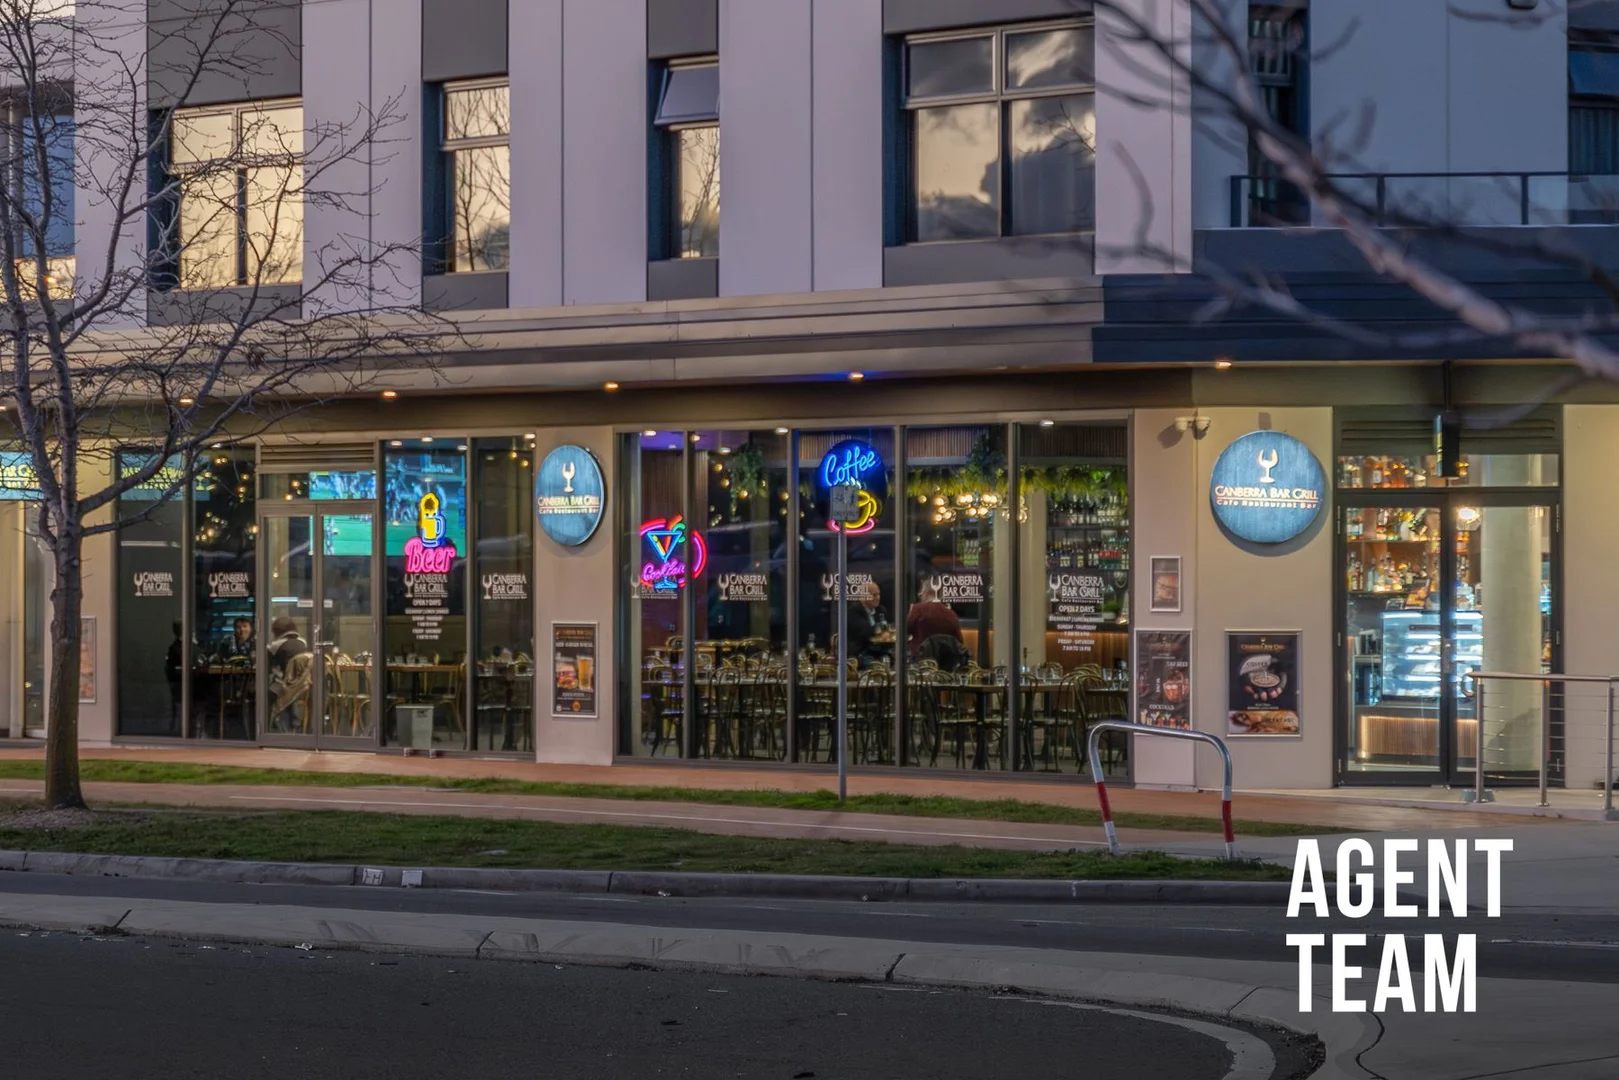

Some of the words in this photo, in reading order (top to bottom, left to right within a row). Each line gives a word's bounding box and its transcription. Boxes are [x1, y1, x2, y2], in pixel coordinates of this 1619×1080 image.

[825, 446, 876, 487] Coffee
[1215, 485, 1268, 498] CANBERRA
[1270, 487, 1290, 499] BAR
[1292, 488, 1319, 500] GRILL
[538, 495, 570, 506] CANBERRA
[570, 495, 583, 506] BAR
[584, 495, 600, 506] GRILL
[1242, 500, 1297, 508] Restaurant
[405, 537, 456, 573] Beer
[730, 573, 767, 585] CANBERRA
[834, 574, 872, 584] CNBERRA
[943, 575, 983, 586] CANBERRA
[1062, 575, 1104, 587] CANBERRA
[730, 585, 744, 595] BAR
[745, 585, 765, 595] GRILL
[834, 585, 849, 594] BR
[943, 587, 958, 597] BAR
[960, 586, 980, 597] GRILL
[1062, 586, 1077, 597] BAR
[1080, 586, 1101, 597] GRILL
[1059, 605, 1074, 613] OPEN
[1080, 605, 1095, 613] DAYS
